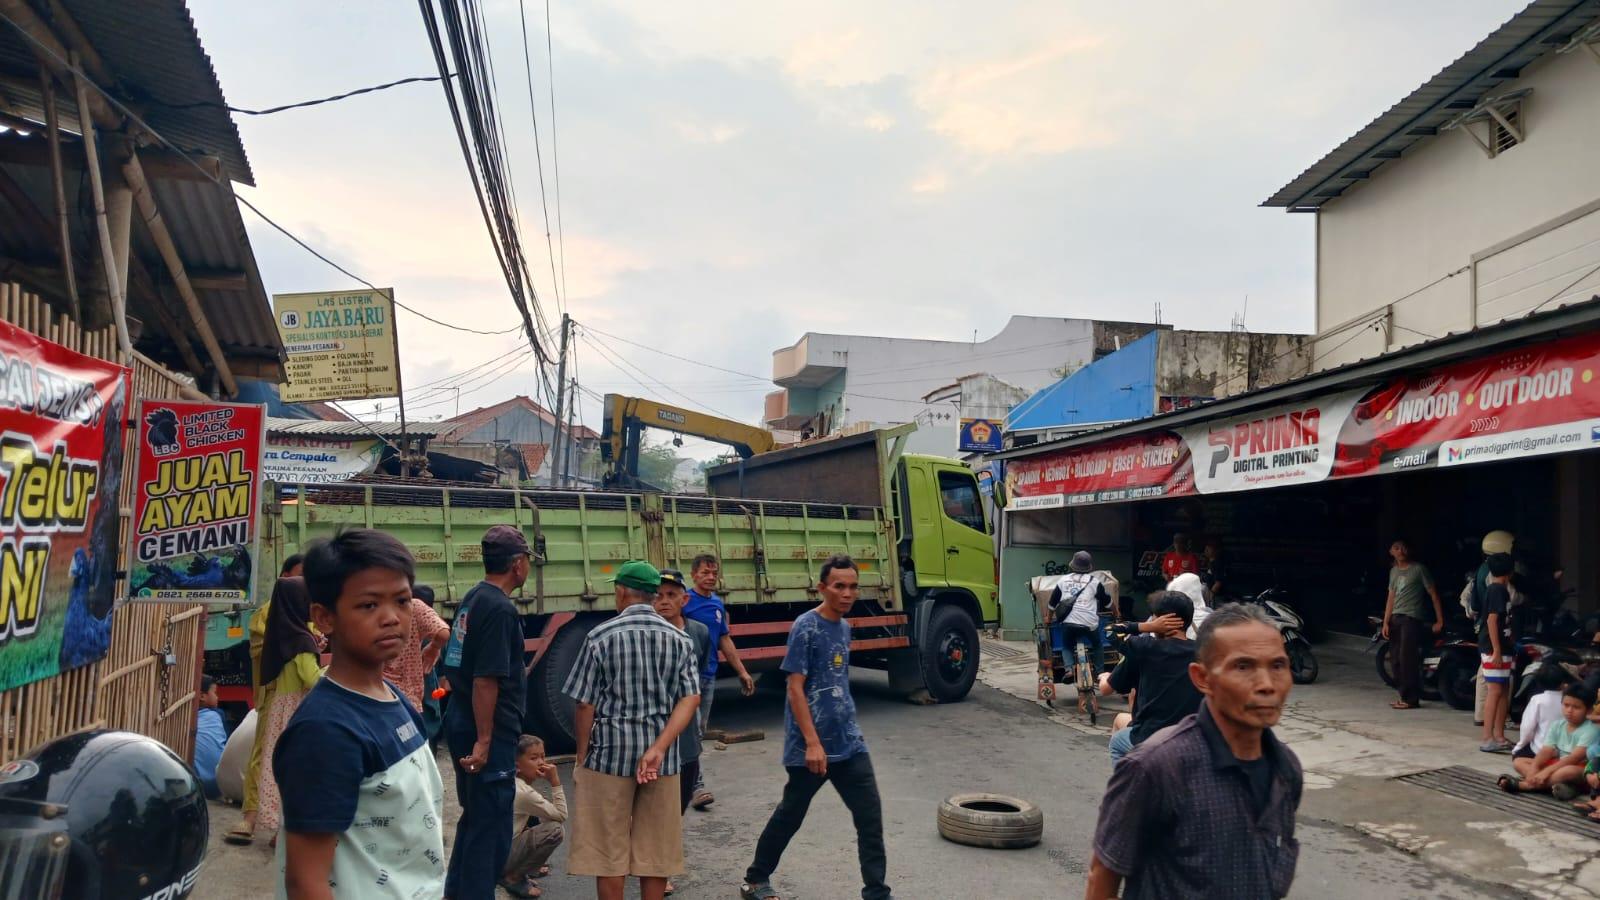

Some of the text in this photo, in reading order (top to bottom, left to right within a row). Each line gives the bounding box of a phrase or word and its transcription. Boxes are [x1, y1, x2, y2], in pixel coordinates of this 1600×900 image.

[338, 295, 373, 305] LISTRIK
[285, 314, 296, 326] JB
[304, 306, 384, 329] JAYA BARU
[1396, 367, 1574, 426] INDOOR OUTDOOR
[183, 408, 234, 426] LIMITED
[185, 422, 229, 437] BLACK
[186, 429, 244, 448] CHICKEN
[1233, 407, 1321, 457] PRIMA
[281, 450, 337, 463] Cempaka
[1111, 452, 1135, 477] JERSEY
[1141, 447, 1173, 468] STICKER
[1233, 448, 1319, 473] DIGITAL PRINTING
[1393, 433, 1581, 468] e-mail primadigprint@gmail.com
[1, 440, 98, 527] Telur
[146, 450, 252, 496] JUAL
[138, 483, 250, 534] AYAM
[140, 521, 248, 561] CEMANI
[157, 591, 183, 599] 0821
[215, 590, 240, 599] 6705
